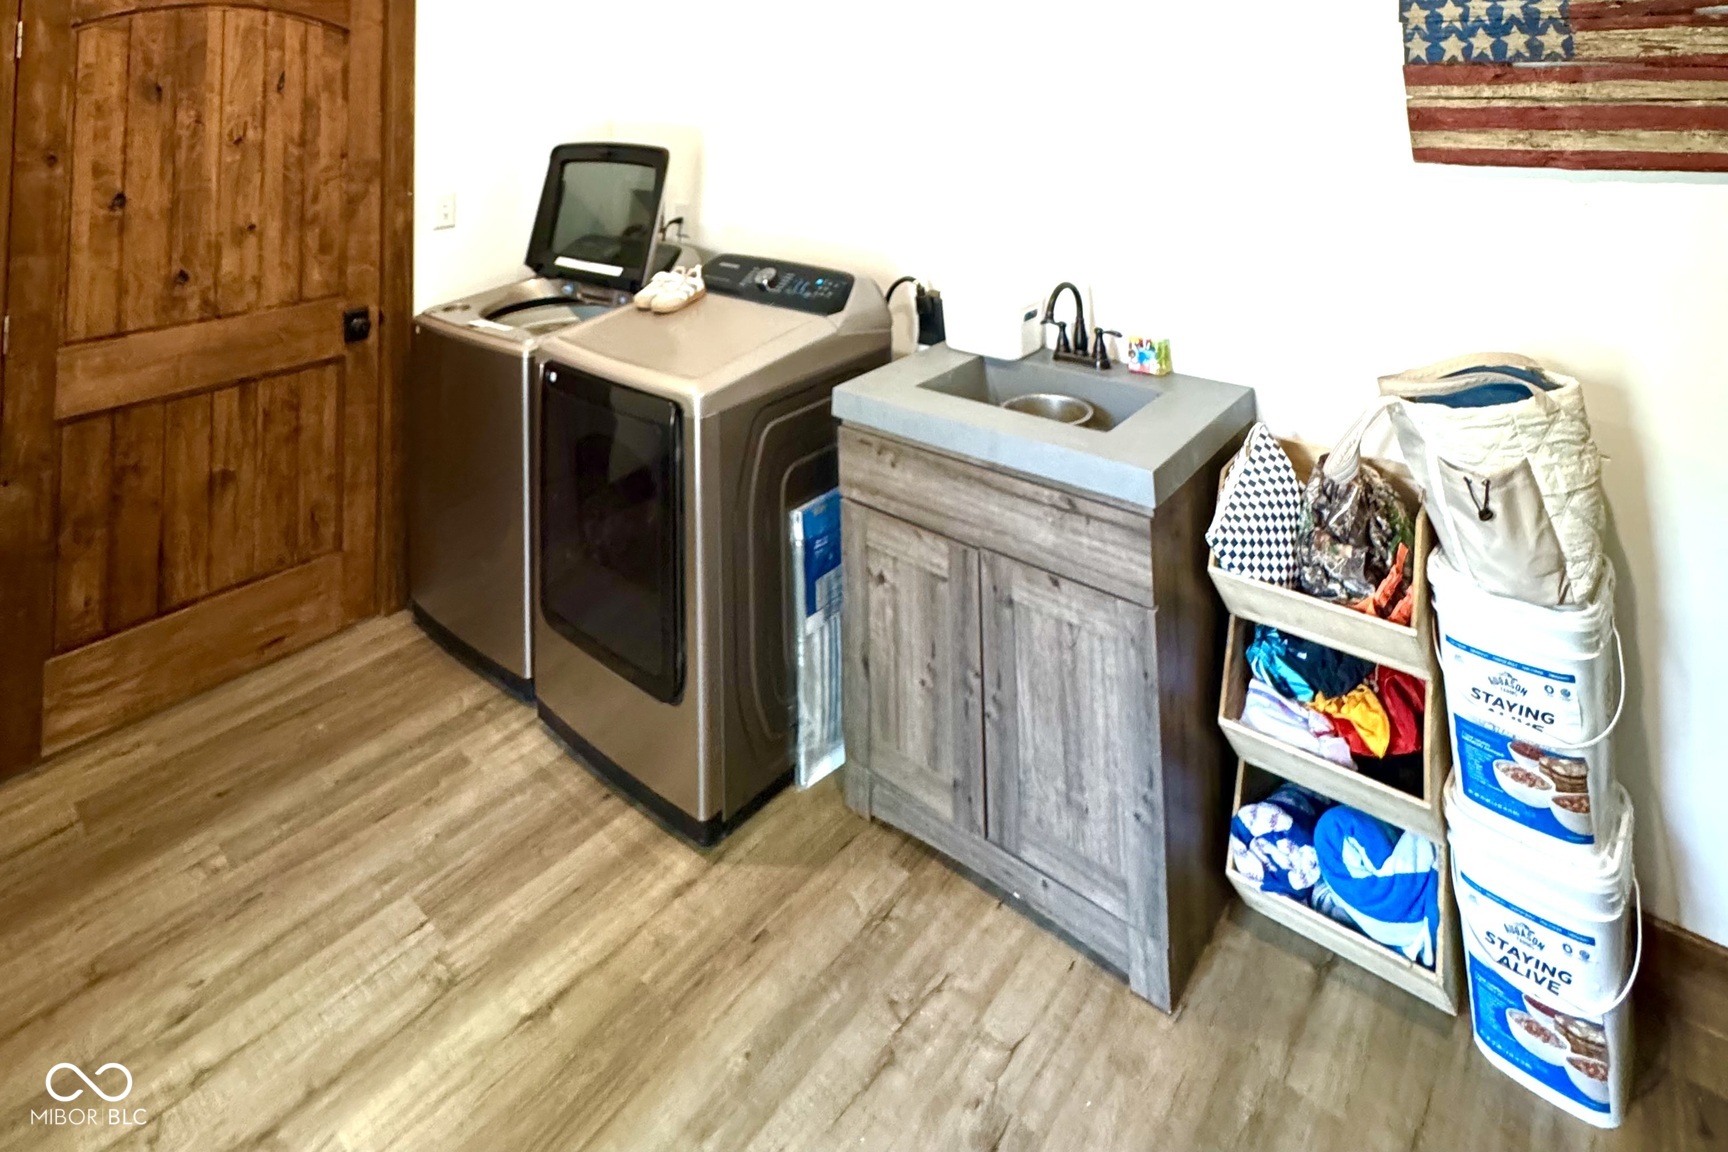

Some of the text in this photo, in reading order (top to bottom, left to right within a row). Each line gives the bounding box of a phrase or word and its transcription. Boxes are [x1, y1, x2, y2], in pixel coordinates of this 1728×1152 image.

[1470, 687, 1555, 725] STAYING
[1484, 930, 1573, 985] STAYING
[1496, 955, 1561, 996] ALIVE
